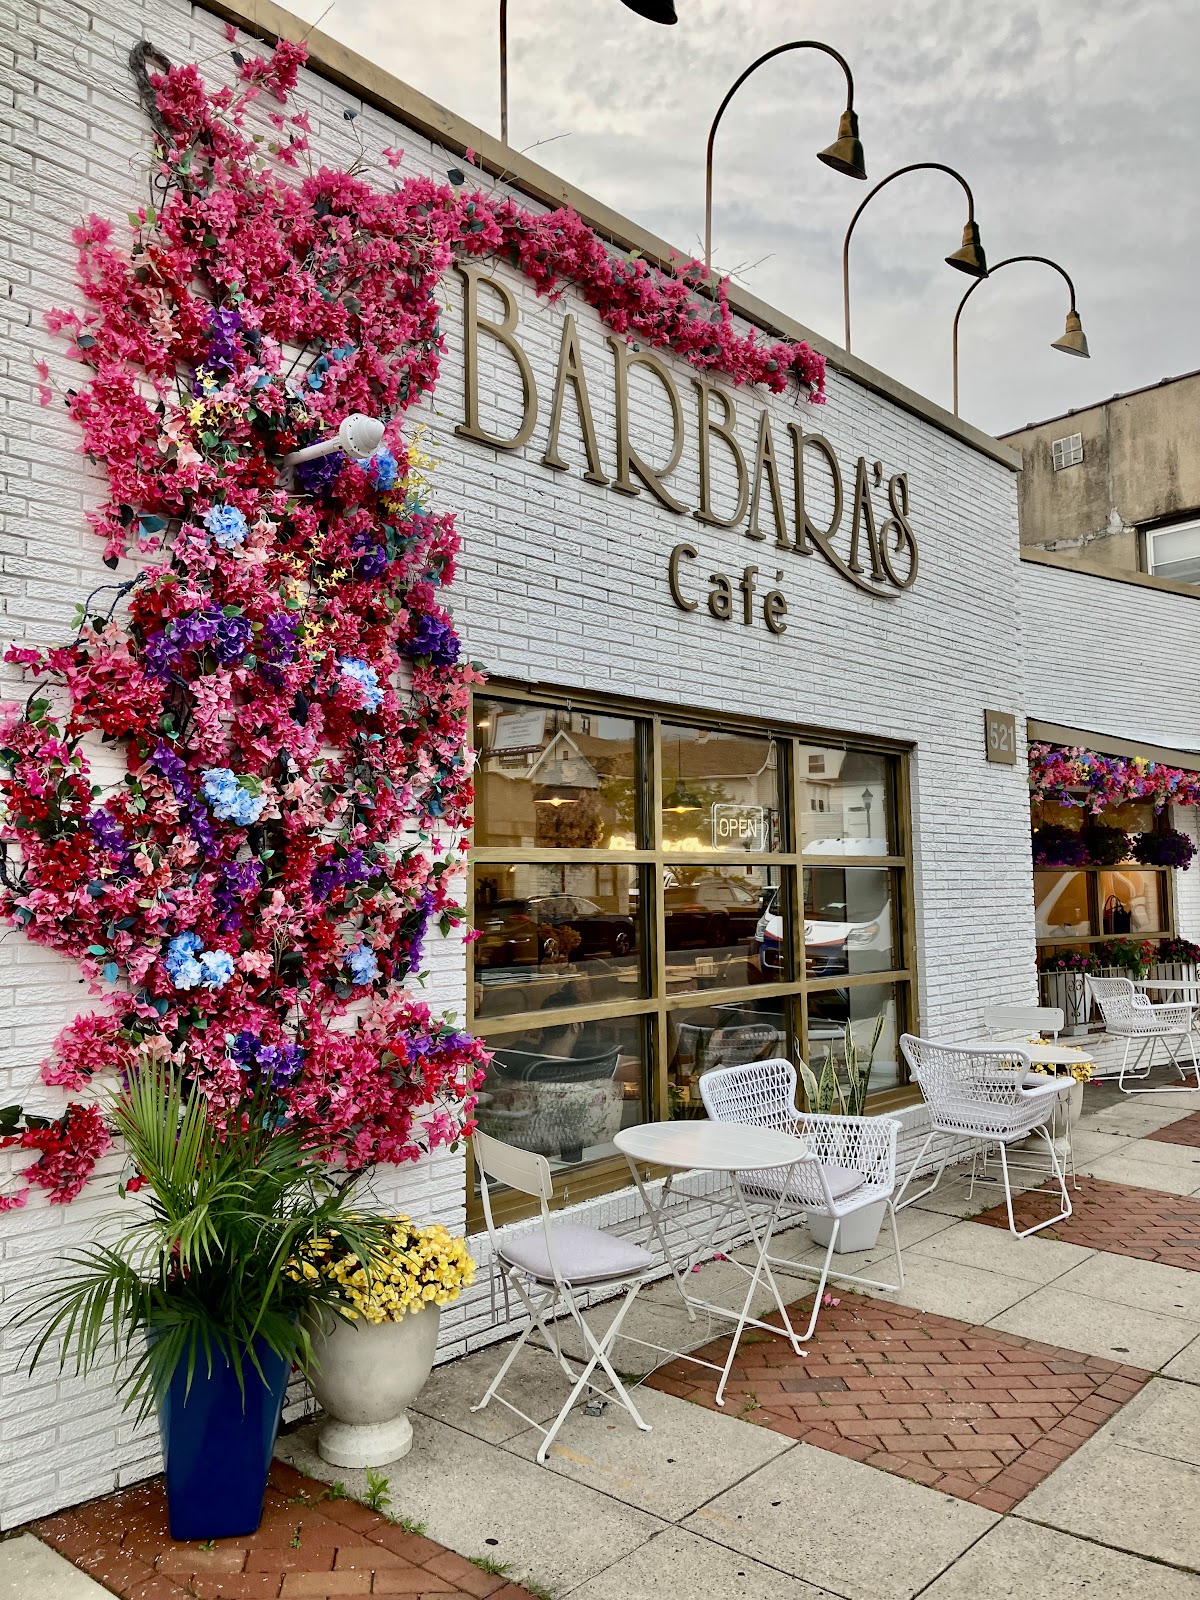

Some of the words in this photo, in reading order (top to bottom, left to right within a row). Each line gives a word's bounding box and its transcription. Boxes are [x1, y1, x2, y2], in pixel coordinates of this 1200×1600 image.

[454, 262, 919, 598] BARBARA'S
[668, 543, 788, 634] Café
[990, 722, 1014, 752] 521
[720, 818, 758, 837] OPEN
